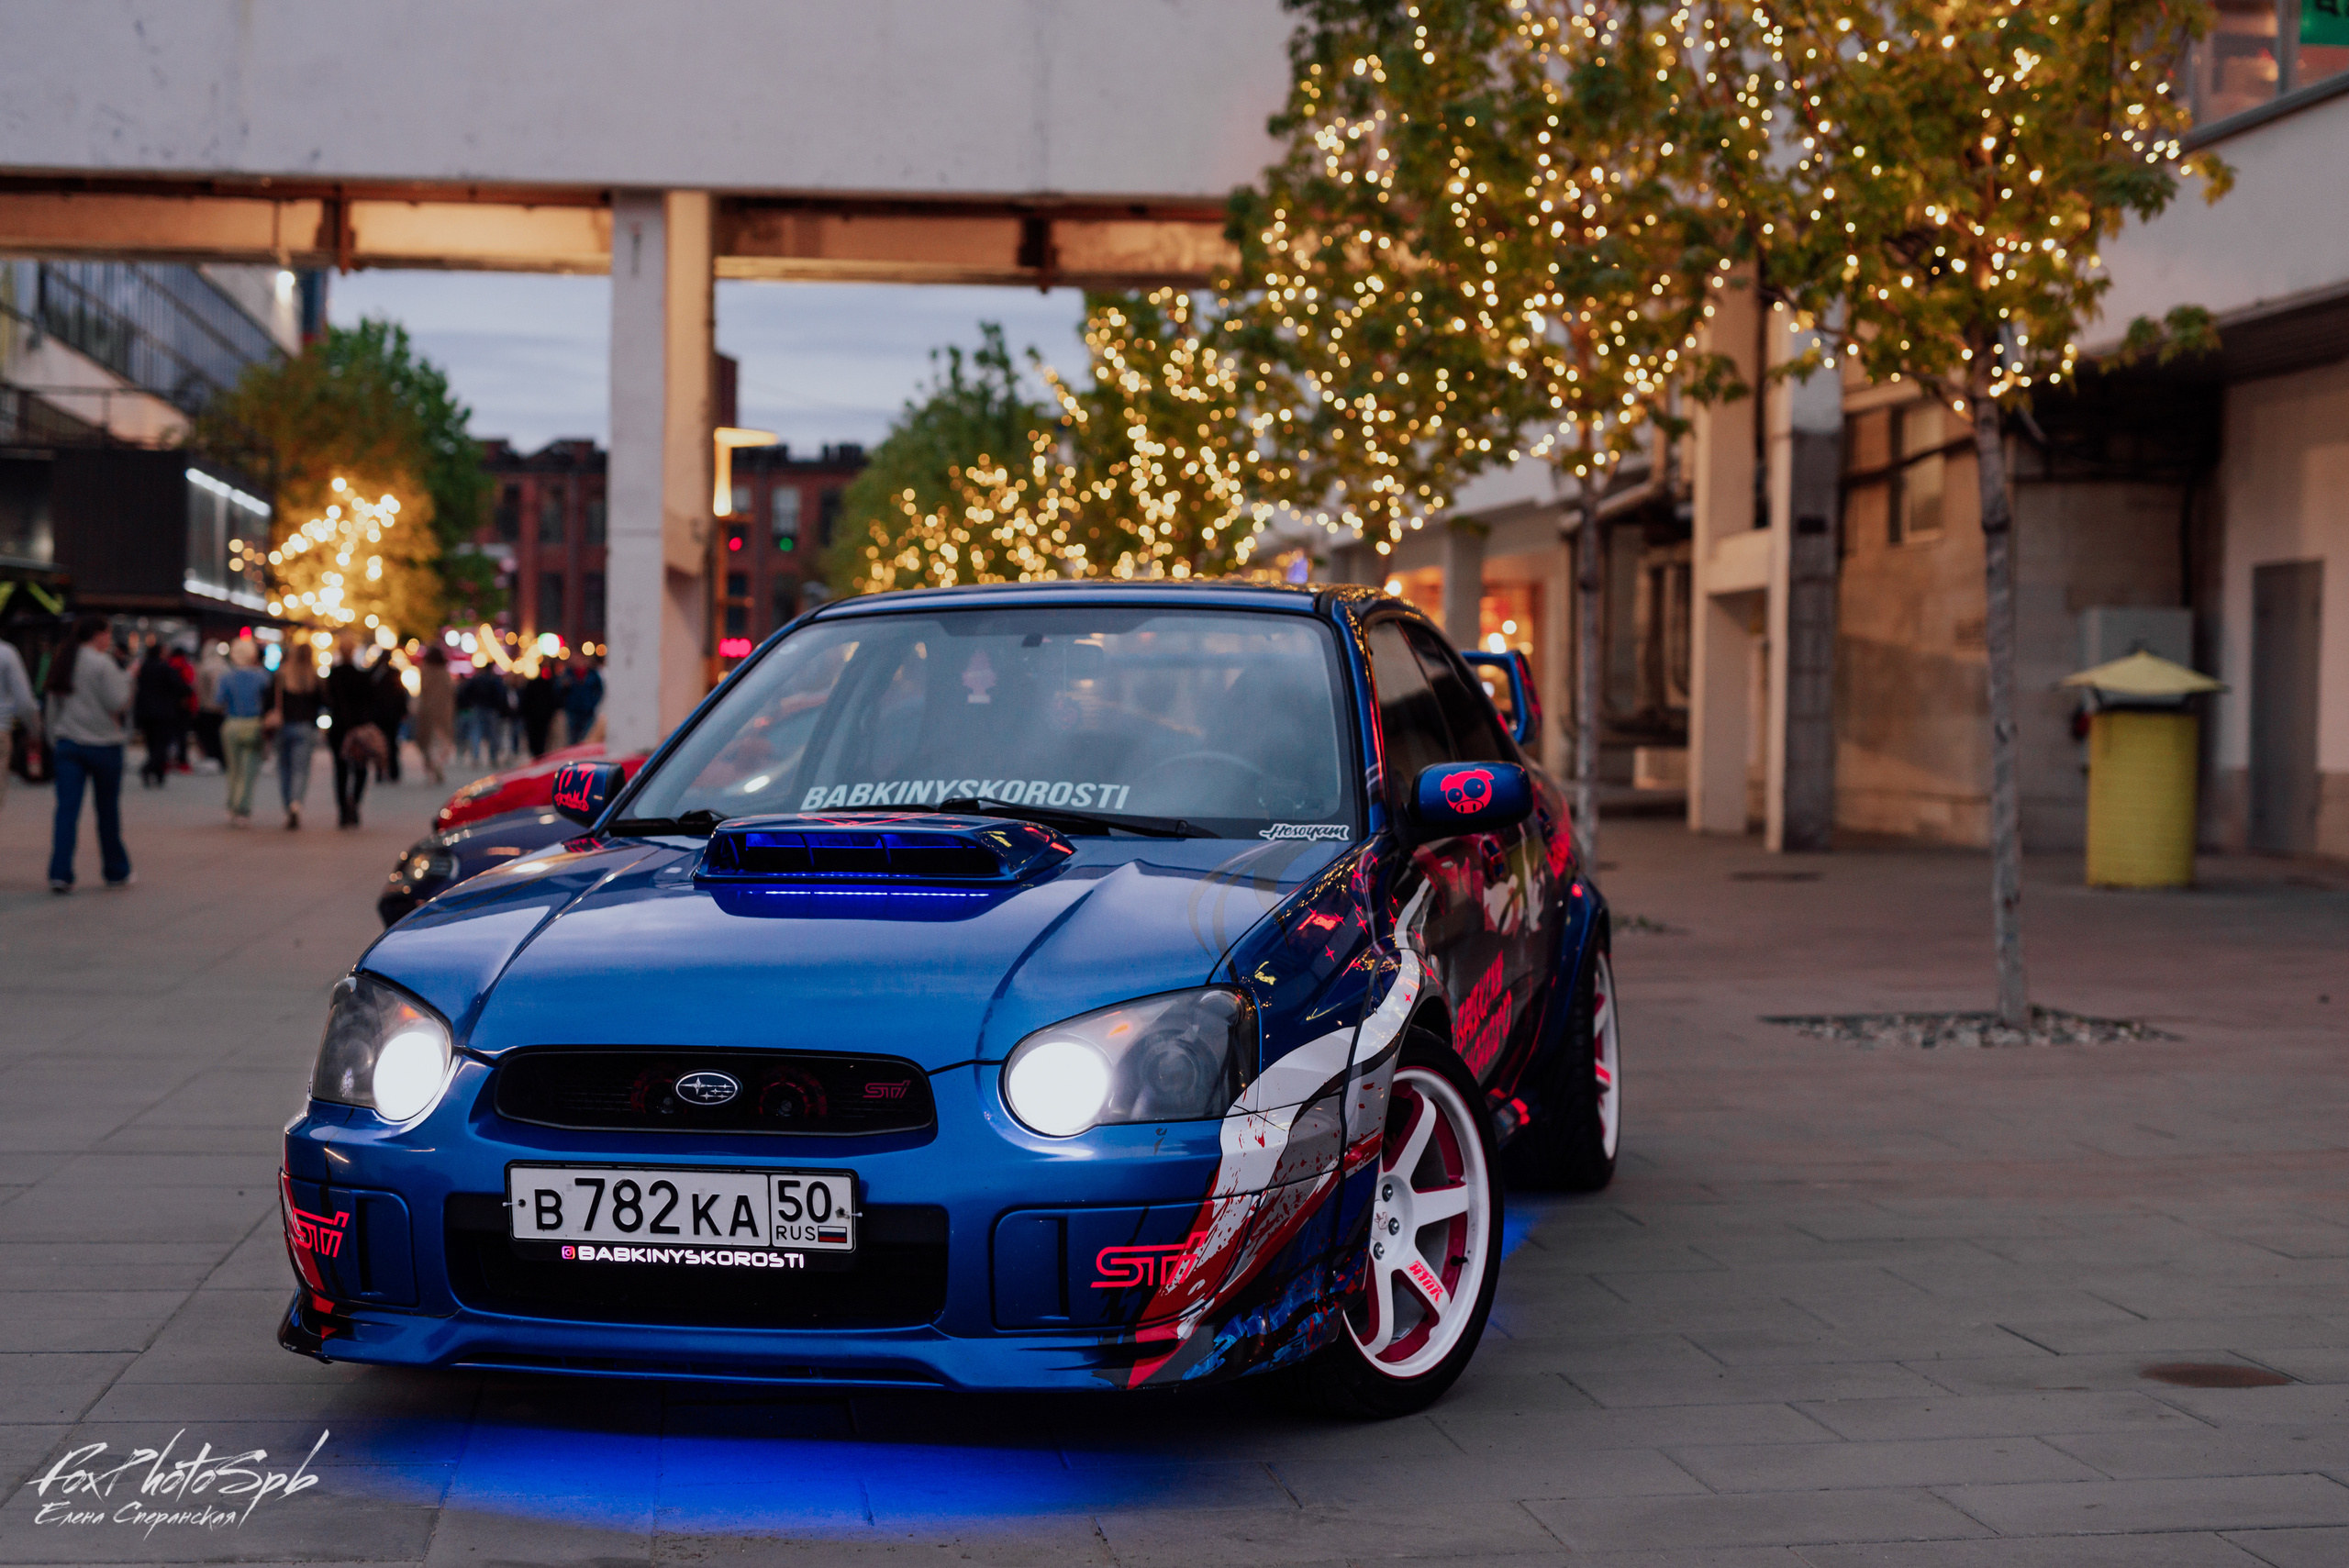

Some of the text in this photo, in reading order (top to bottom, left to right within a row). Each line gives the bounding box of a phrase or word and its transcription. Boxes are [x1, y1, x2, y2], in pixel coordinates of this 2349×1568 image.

[800, 780, 1130, 811] BABKINYSKOROSTI
[1259, 823, 1350, 841] Hesoyam
[777, 1179, 831, 1223] 50
[775, 1225, 816, 1241] RUS
[578, 1246, 805, 1269] BABKINYSKOROSTI
